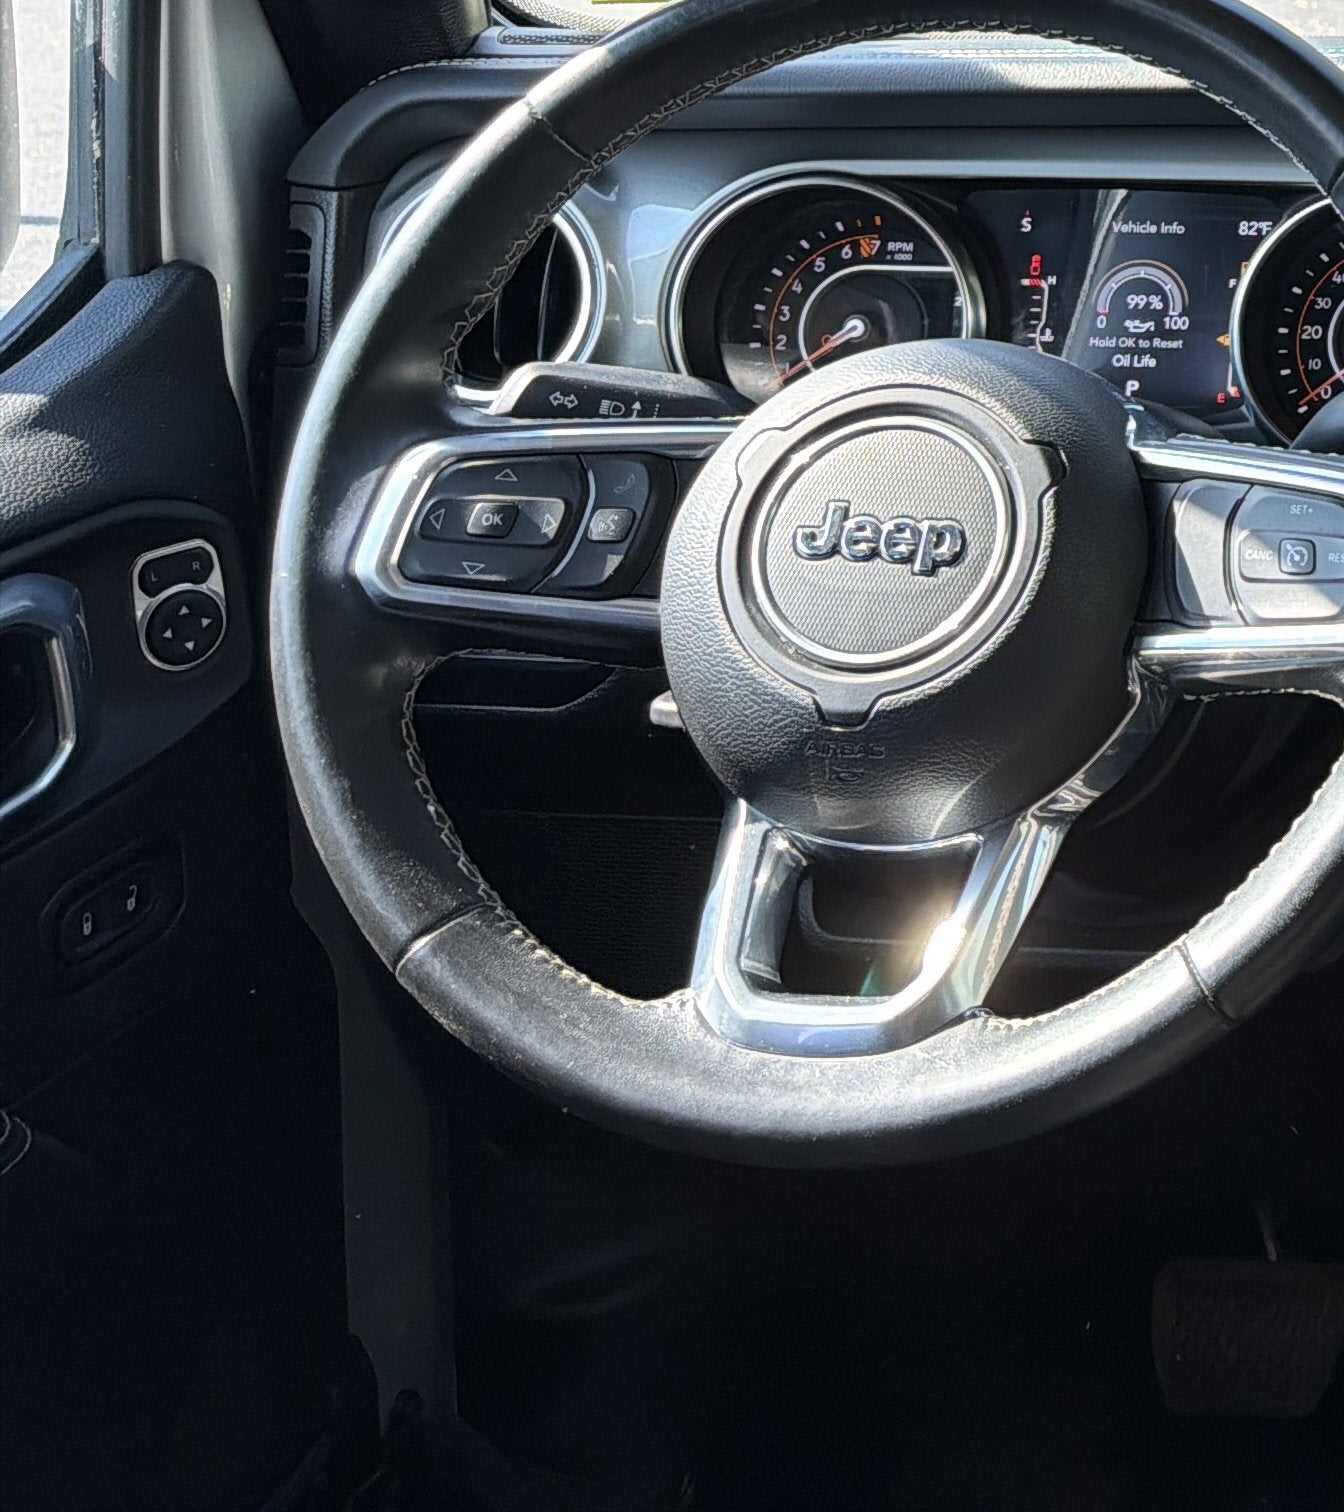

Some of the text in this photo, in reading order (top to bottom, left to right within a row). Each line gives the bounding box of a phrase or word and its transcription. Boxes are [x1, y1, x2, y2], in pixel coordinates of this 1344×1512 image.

[1020, 217, 1033, 233] S
[1112, 220, 1186, 235] Vehicle Info
[1238, 220, 1273, 236] 82°F
[841, 243, 853, 260] 6
[871, 240, 881, 255] 7
[886, 241, 914, 253] RPM
[813, 256, 826, 273] 5
[791, 278, 803, 294] 4
[1047, 276, 1057, 287] H
[1228, 278, 1237, 289] F
[1314, 297, 1332, 310] 30
[778, 305, 791, 322] 3
[1096, 316, 1190, 331] 0 100
[1301, 325, 1323, 340] 20
[775, 334, 787, 351] 2
[1089, 336, 1184, 349] Hold OK to Reset
[1112, 353, 1157, 368] Oil Life
[1308, 359, 1322, 371] 10
[1125, 380, 1140, 397] P
[1320, 385, 1332, 399] 0
[1216, 392, 1226, 404] E
[481, 513, 504, 527] OK
[793, 500, 967, 576] Jeep
[1244, 549, 1275, 562] CANC
[191, 560, 201, 571] R
